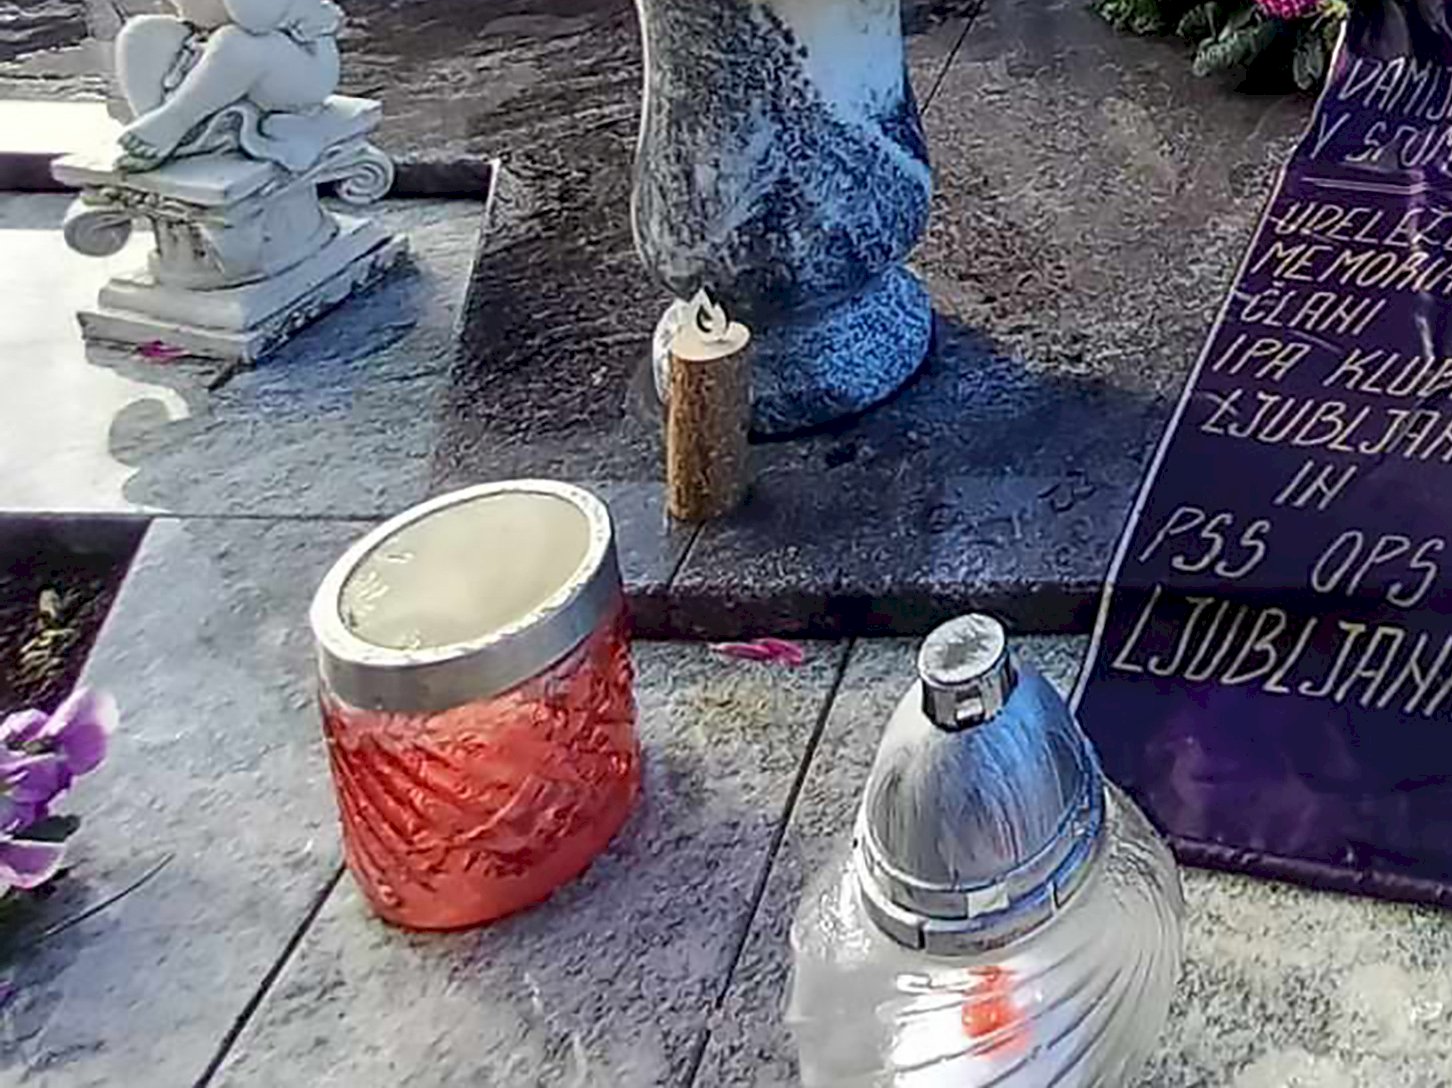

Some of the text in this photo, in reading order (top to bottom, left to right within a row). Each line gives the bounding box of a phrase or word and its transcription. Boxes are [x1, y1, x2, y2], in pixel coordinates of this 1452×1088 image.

[1212, 333, 1311, 382] IPA
[1138, 506, 1445, 607] PSS OPS
